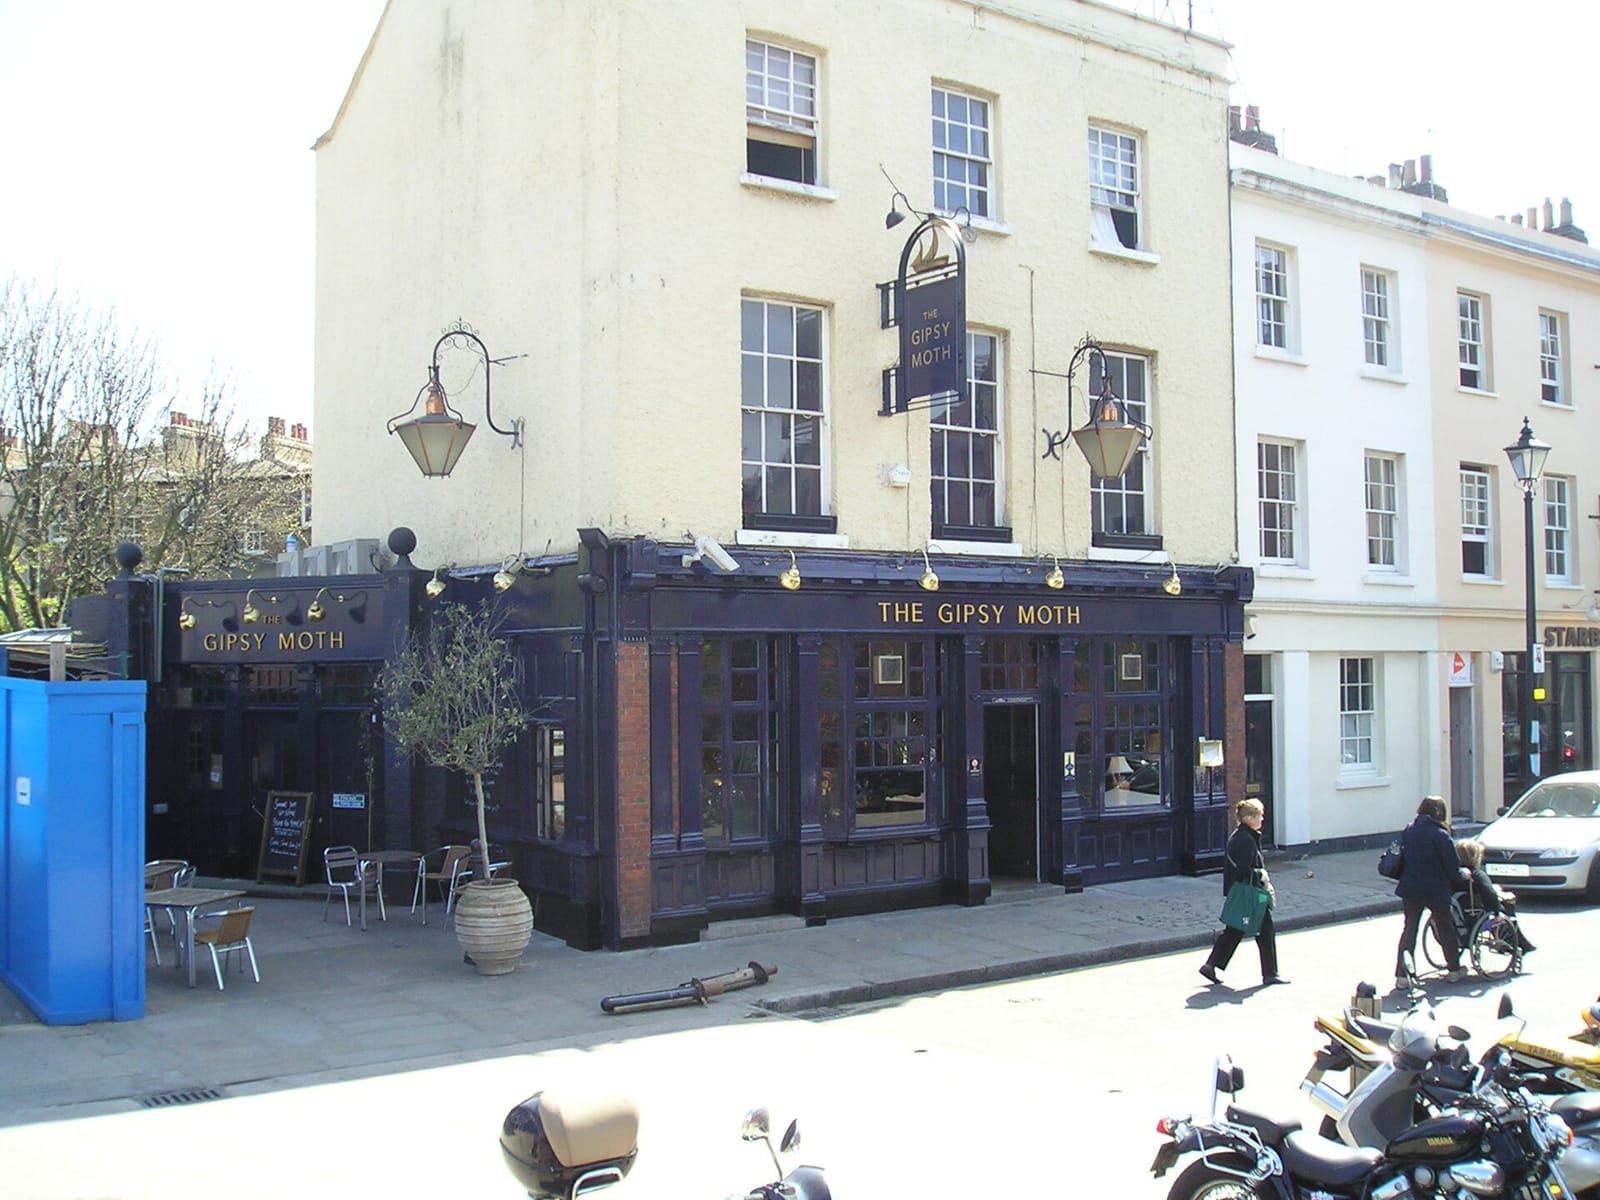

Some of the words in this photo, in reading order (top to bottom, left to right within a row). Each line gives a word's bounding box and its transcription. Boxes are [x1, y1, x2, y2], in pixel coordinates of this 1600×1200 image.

[923, 308, 938, 320] THE
[911, 321, 950, 345] GIPSY
[911, 344, 951, 368] MOTH
[263, 615, 282, 625] THE
[878, 602, 924, 623] THE
[938, 603, 1005, 624] GIPSY
[1018, 605, 1081, 625] MOTH
[204, 633, 267, 651] GIPSY
[278, 631, 344, 650] MOTH
